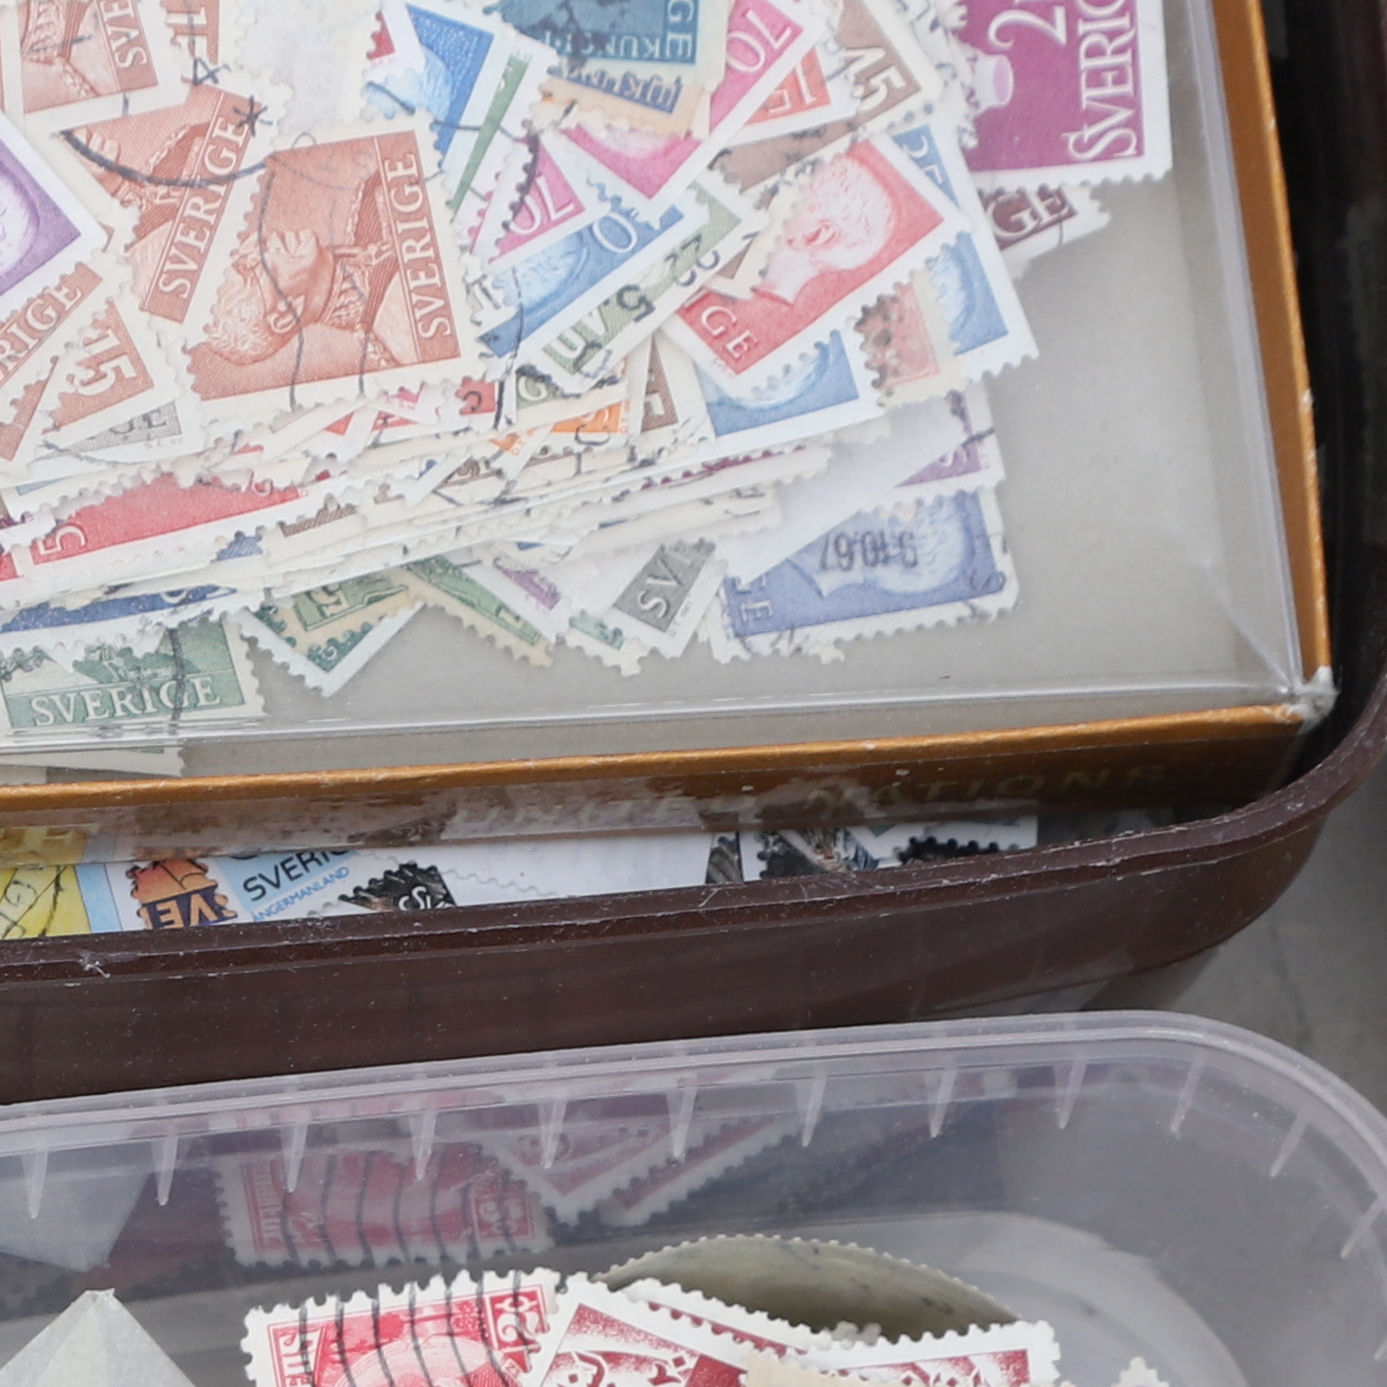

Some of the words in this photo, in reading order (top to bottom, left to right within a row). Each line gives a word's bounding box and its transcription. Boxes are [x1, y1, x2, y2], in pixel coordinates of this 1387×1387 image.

[158, 117, 250, 298] SVERIGE
[385, 152, 453, 341] SVERIGE
[30, 674, 223, 728] SVERIGE
